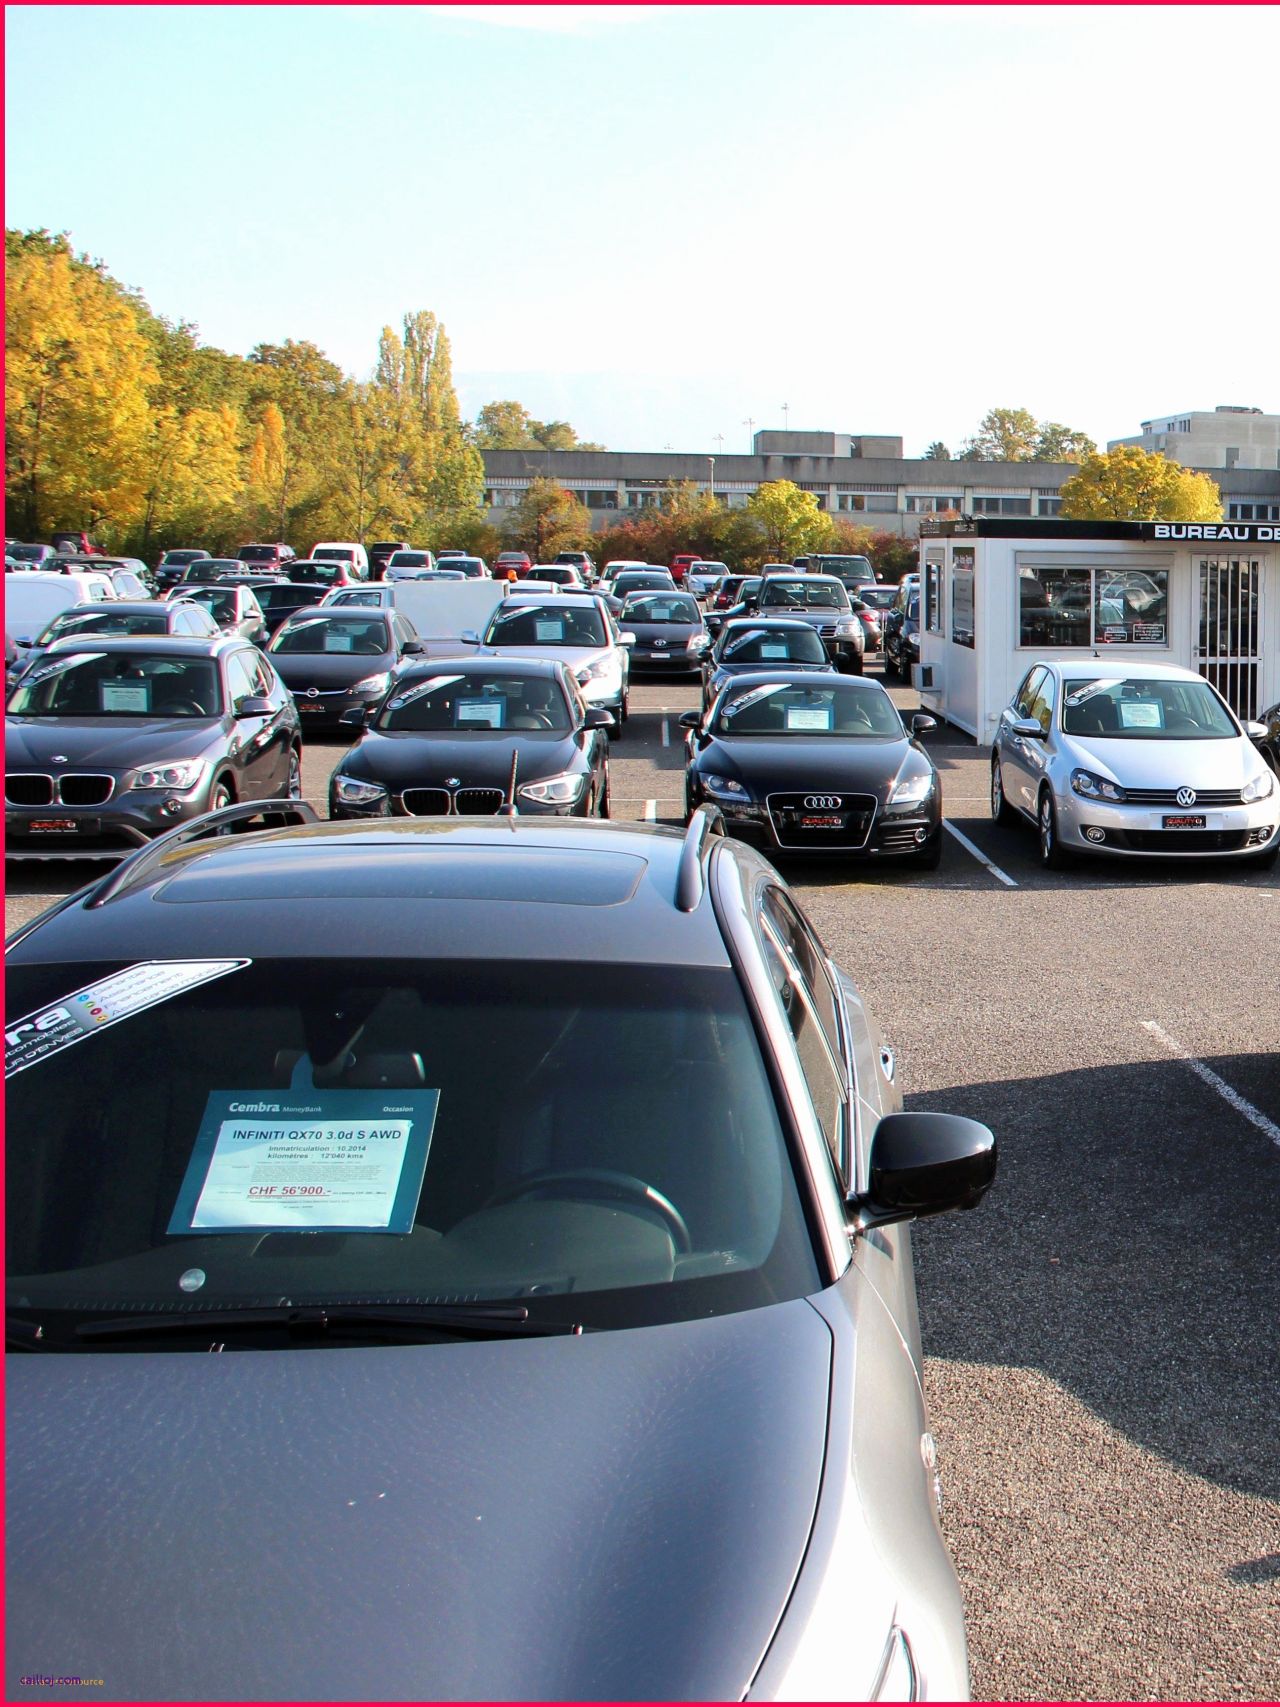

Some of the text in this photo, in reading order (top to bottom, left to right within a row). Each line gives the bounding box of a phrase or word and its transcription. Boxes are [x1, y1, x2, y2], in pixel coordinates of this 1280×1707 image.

[1154, 524, 1249, 540] BUREAU
[5, 1006, 72, 1046] ra
[5, 1019, 76, 1057] tomobiles
[229, 1102, 322, 1114] Cembra MoneyBank
[233, 1130, 401, 1140] INFINITI QX70 3.0d S AWD
[249, 1186, 277, 1195] CHF
